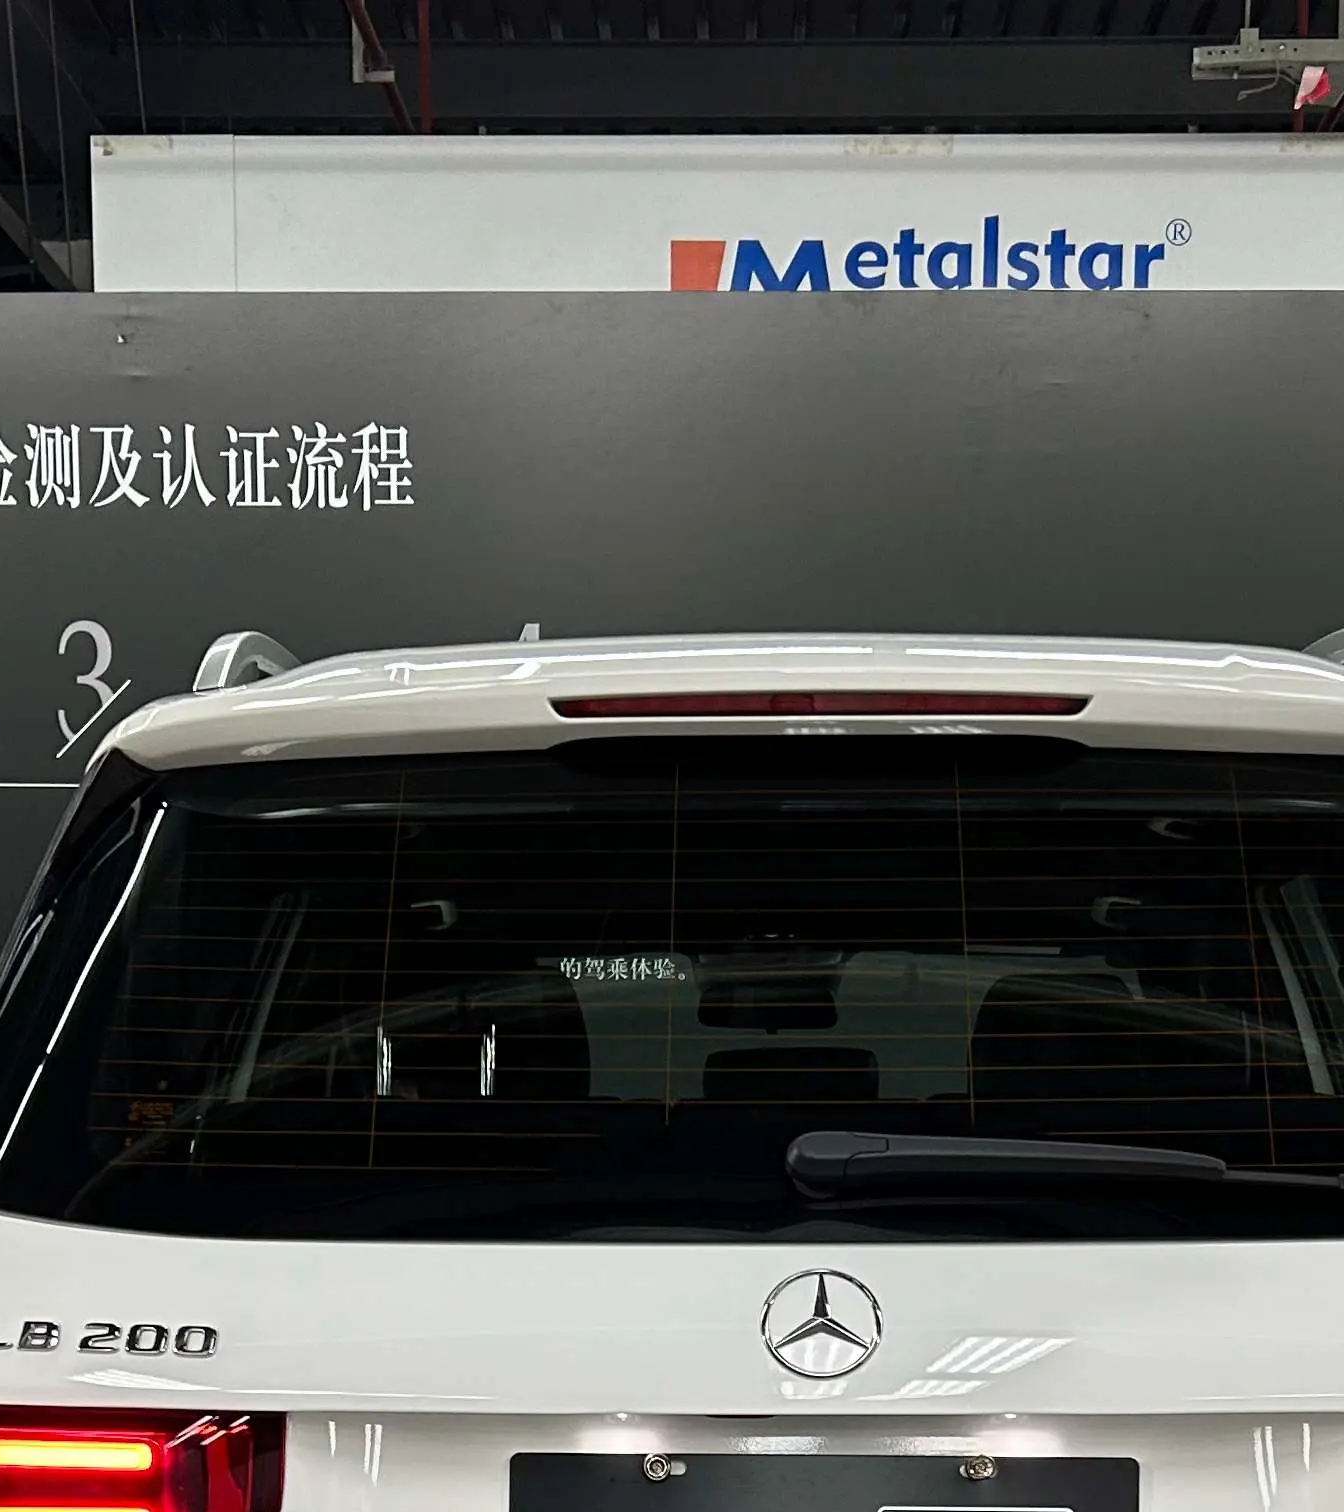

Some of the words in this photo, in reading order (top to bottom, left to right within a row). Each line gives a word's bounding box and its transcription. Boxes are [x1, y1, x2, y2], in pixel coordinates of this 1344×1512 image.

[58, 620, 113, 744] 3
[561, 958, 685, 980] 的驾乘体验。
[79, 1323, 217, 1358] 200
